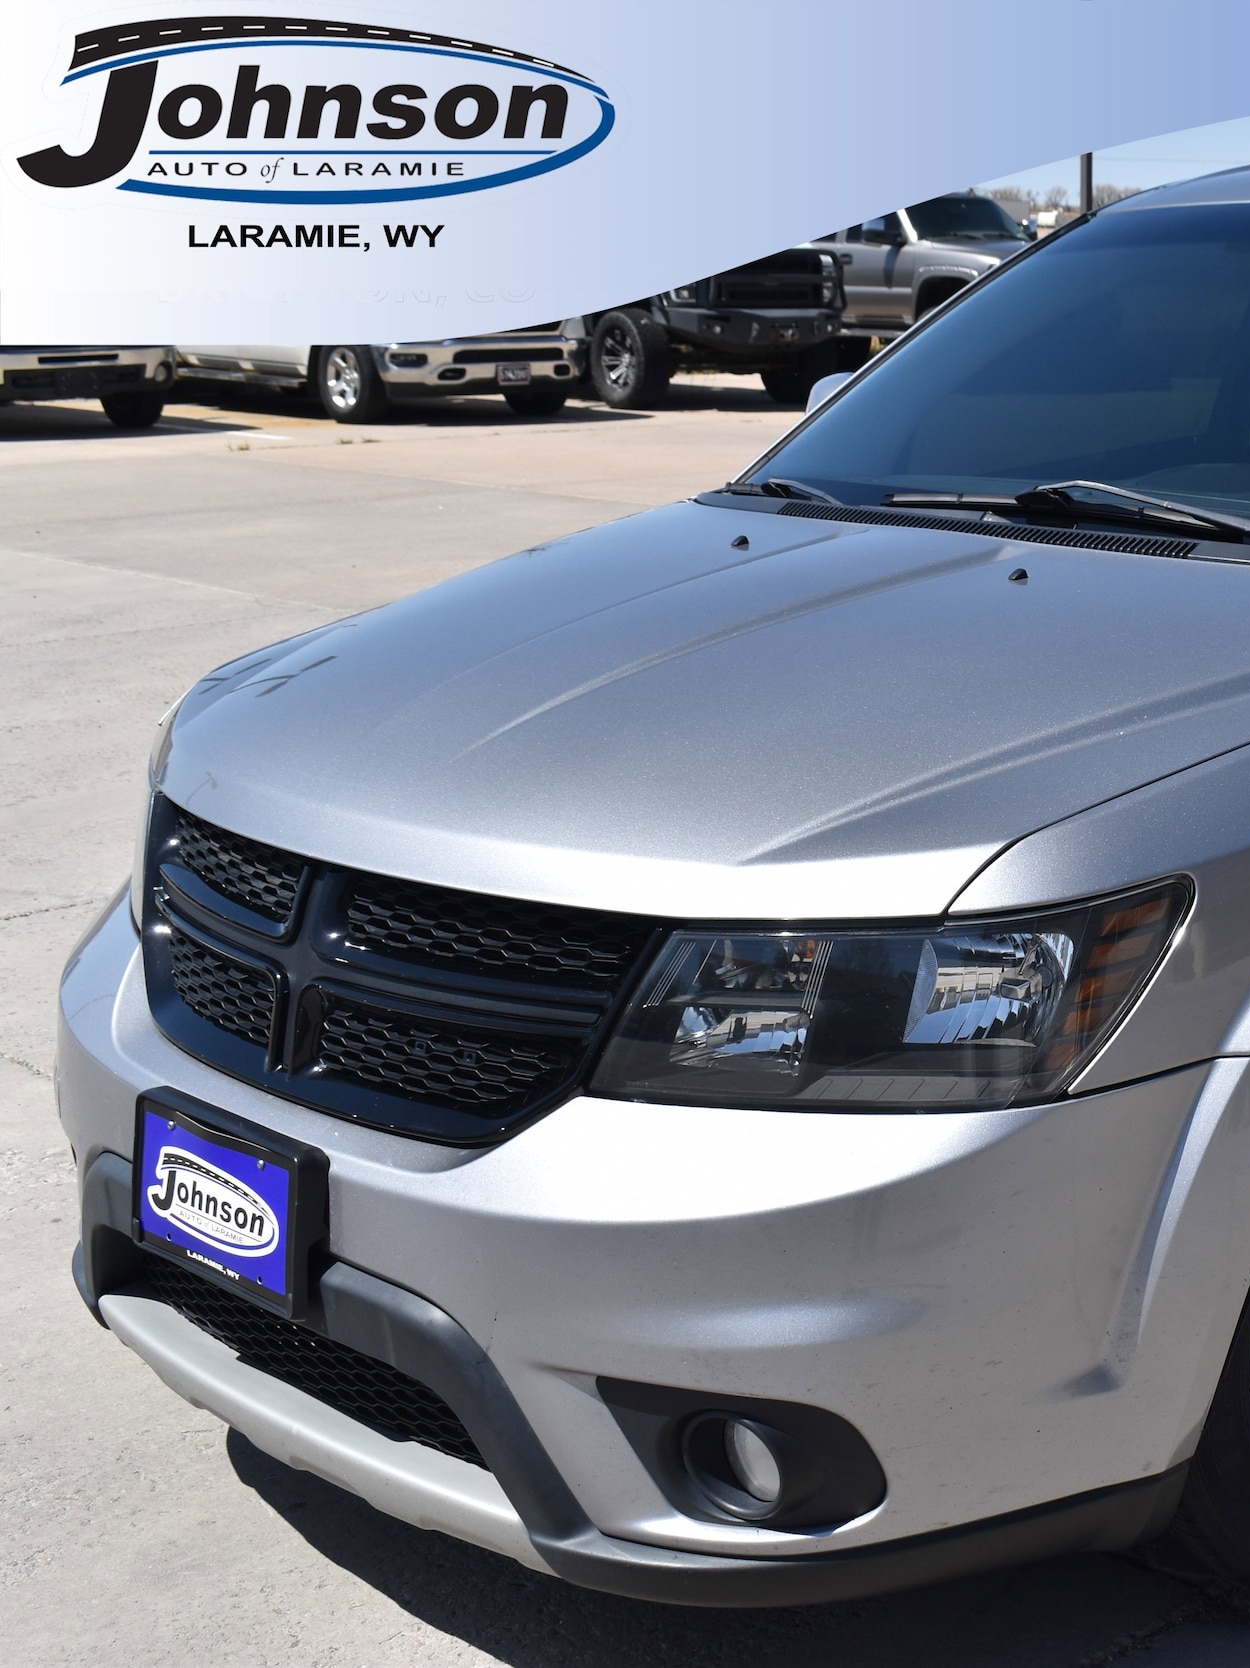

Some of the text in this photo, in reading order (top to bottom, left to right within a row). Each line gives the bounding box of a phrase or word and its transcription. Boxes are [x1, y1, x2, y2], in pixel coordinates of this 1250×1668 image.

[151, 1170, 265, 1237] Johnson
[179, 1211, 203, 1225] AUTO
[211, 1225, 245, 1244] LARAMIE
